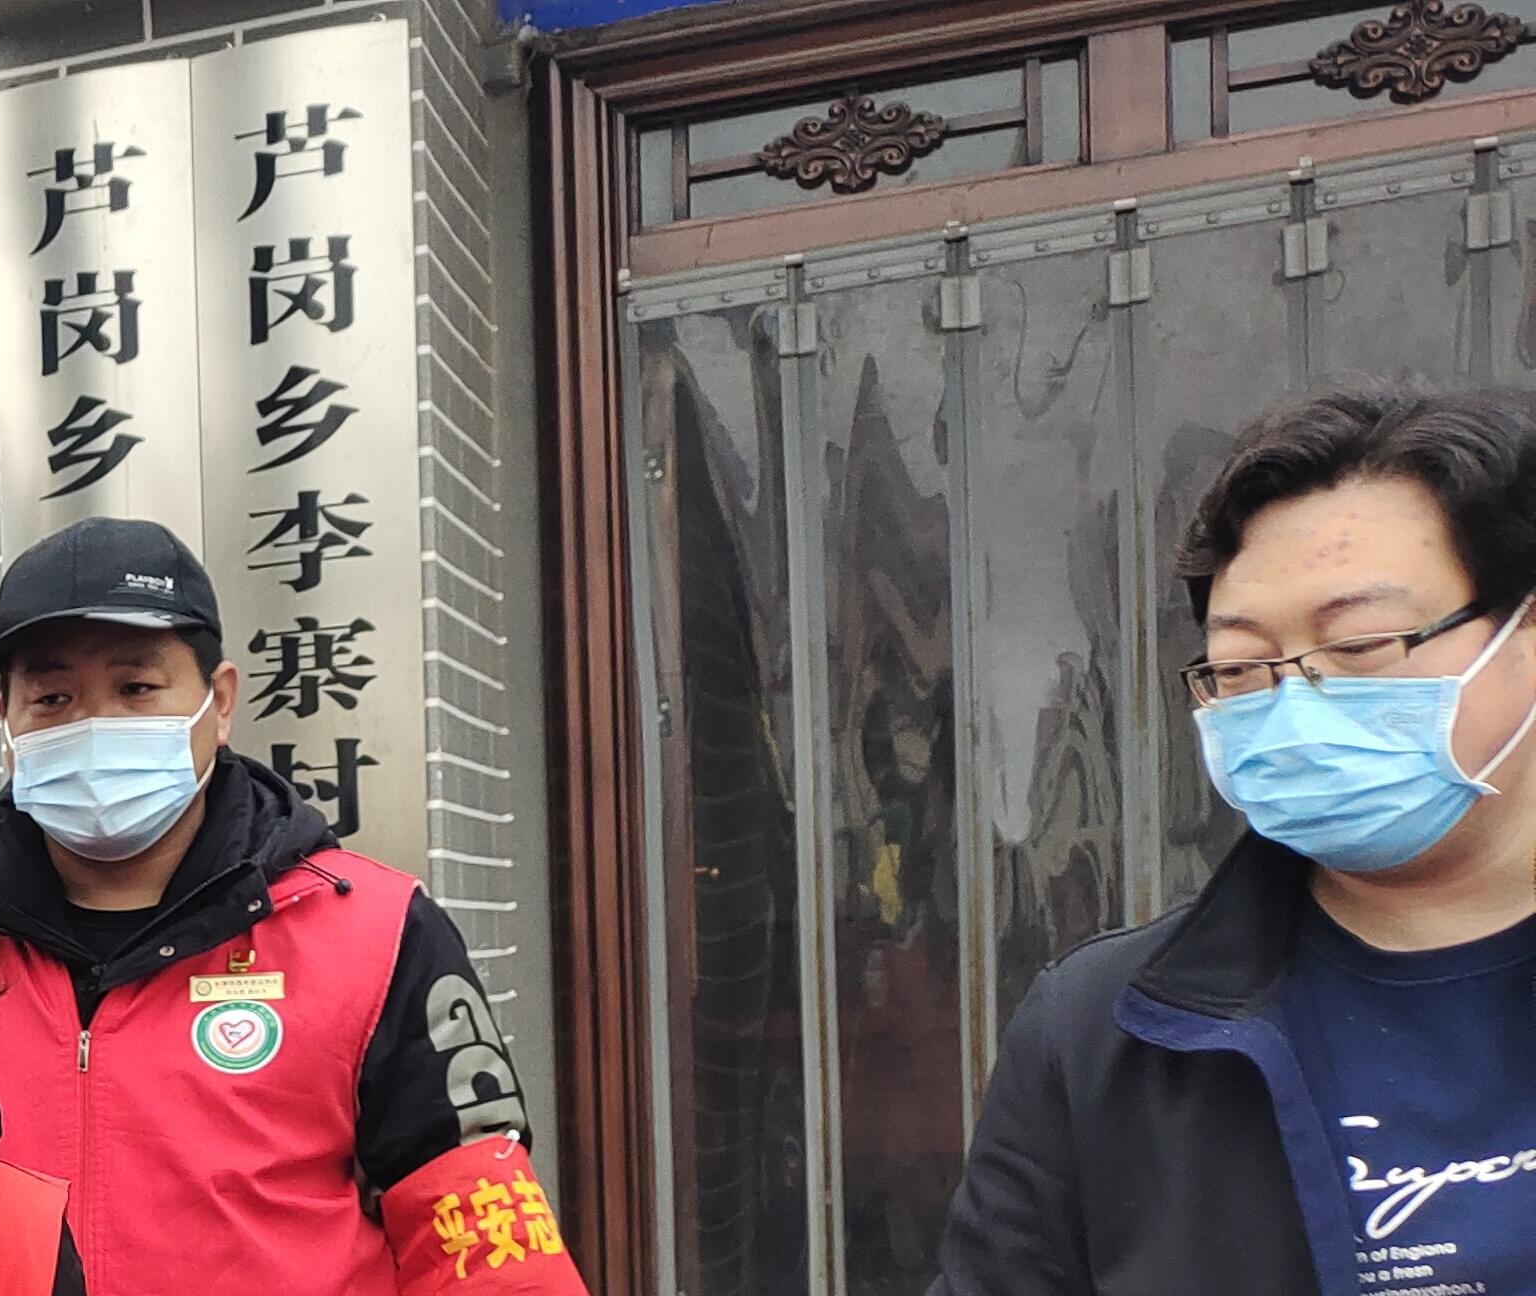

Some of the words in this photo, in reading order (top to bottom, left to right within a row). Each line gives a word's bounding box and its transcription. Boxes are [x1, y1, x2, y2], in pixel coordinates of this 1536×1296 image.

[26, 140, 149, 502] 芦岗乡
[233, 103, 380, 841] 芦岗乡李寨村
[432, 1168, 565, 1280] 平安志
